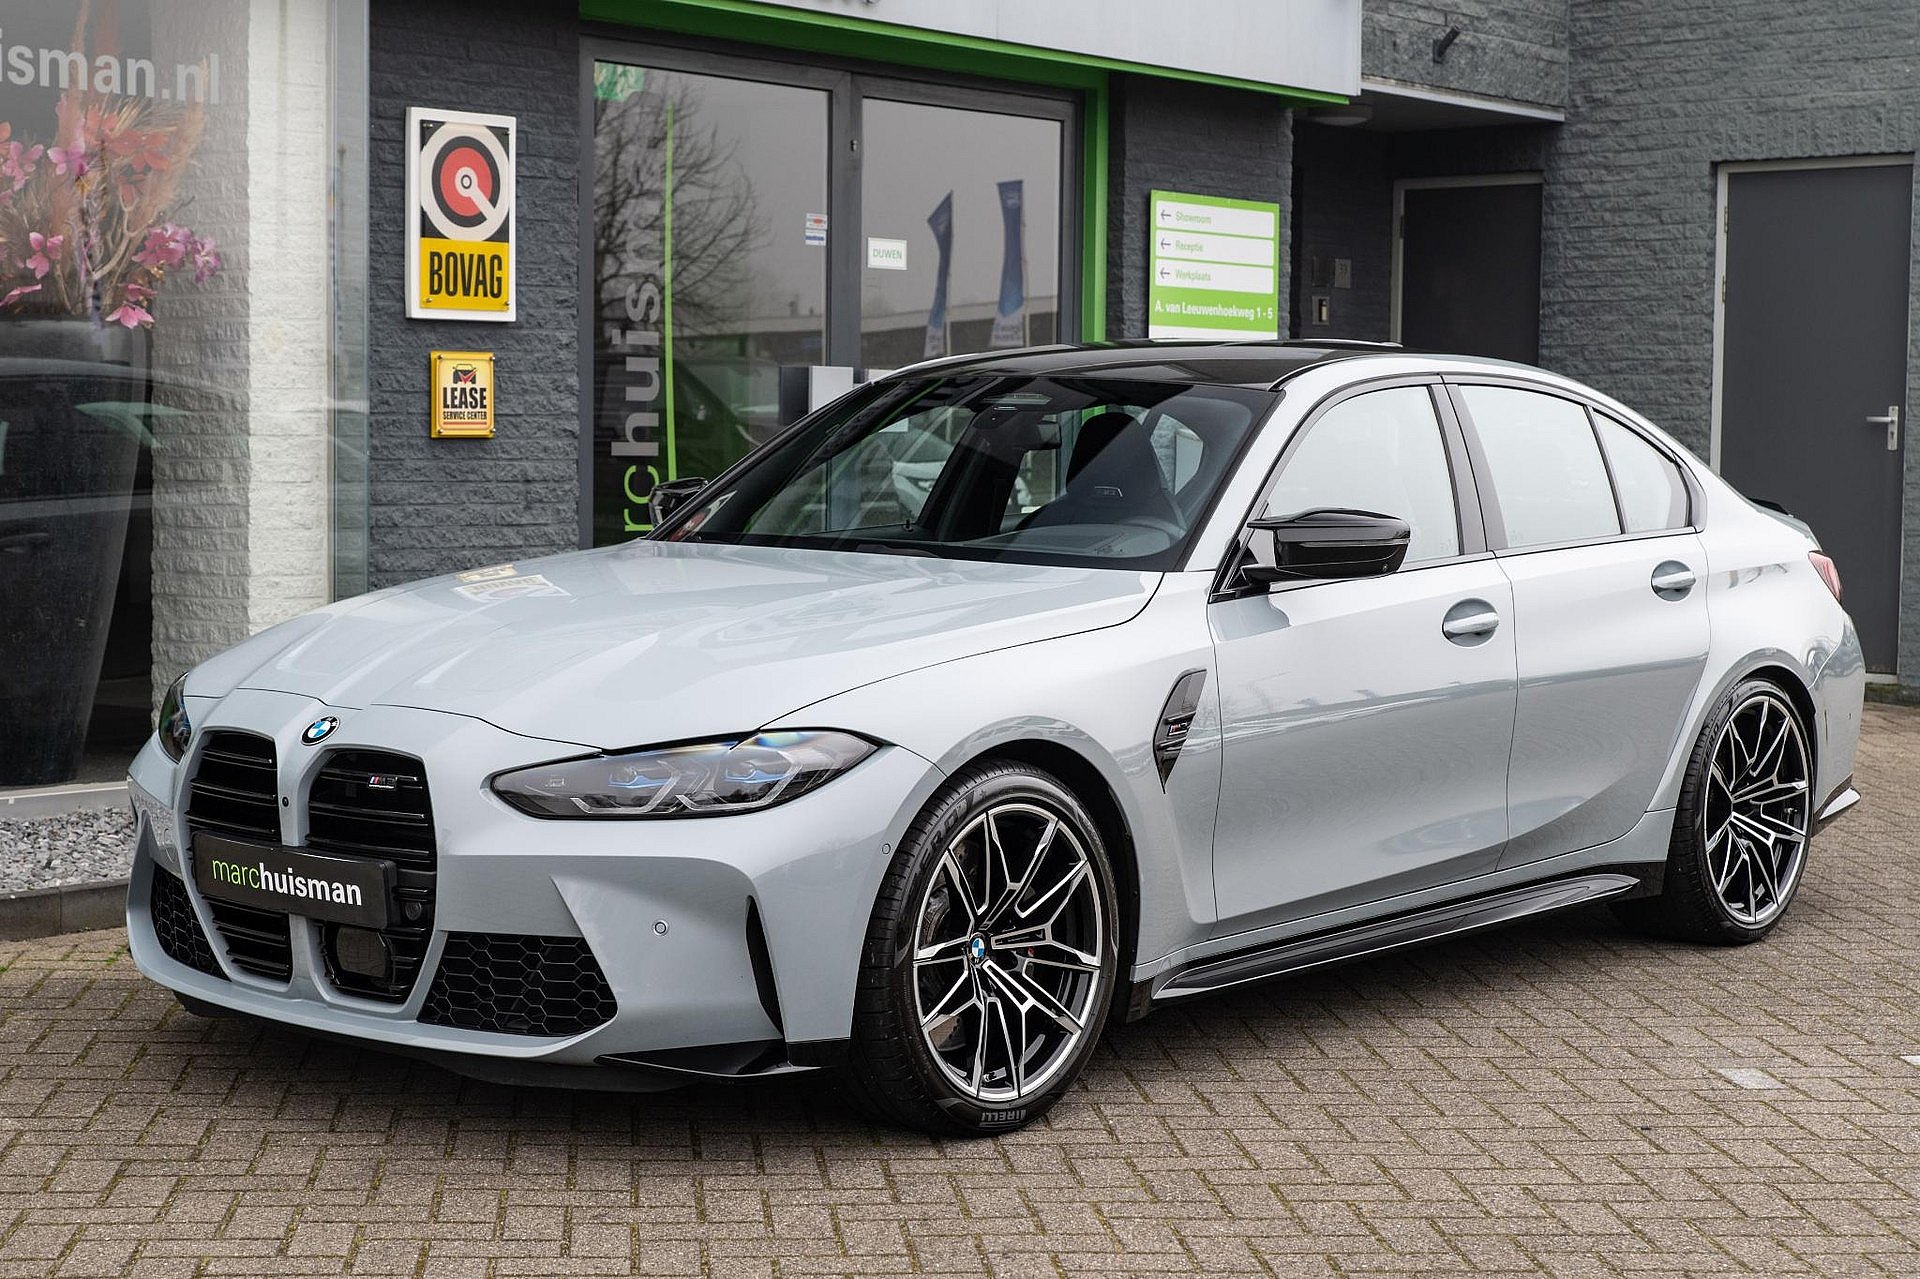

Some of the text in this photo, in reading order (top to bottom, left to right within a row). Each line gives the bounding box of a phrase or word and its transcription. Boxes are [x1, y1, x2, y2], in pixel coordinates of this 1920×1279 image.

[0, 28, 220, 104] sman.nl
[872, 248, 902, 260] DUWEN
[429, 251, 503, 299] BOVAG
[1155, 300, 1164, 312] A.
[1166, 303, 1180, 313] van
[1182, 303, 1255, 321] Leeuwenhoekweg
[1268, 308, 1273, 320] 5
[443, 387, 487, 409] LEASE
[443, 411, 487, 420] SERVICE CENTER
[212, 860, 362, 906] marchuisman
